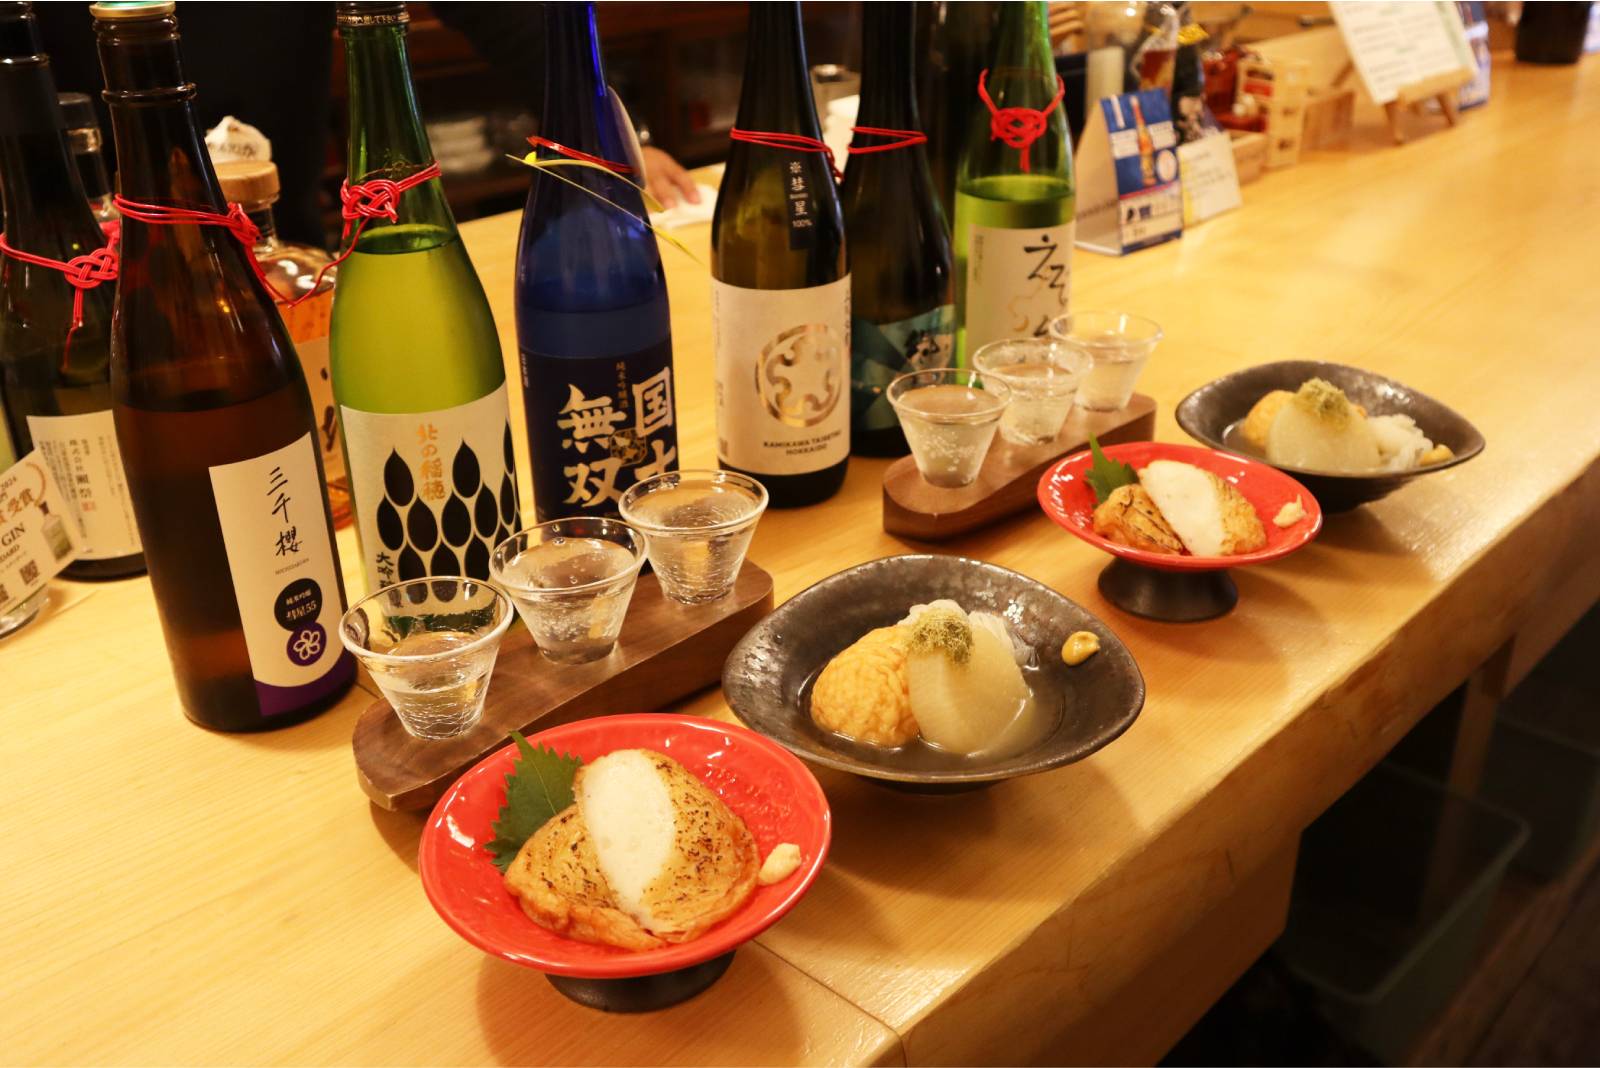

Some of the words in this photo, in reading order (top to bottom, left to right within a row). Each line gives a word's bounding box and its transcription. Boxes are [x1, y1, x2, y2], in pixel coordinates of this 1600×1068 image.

[556, 384, 628, 508] 無双
[1, 523, 26, 547] GIN
[266, 466, 303, 556] 三千櫻
